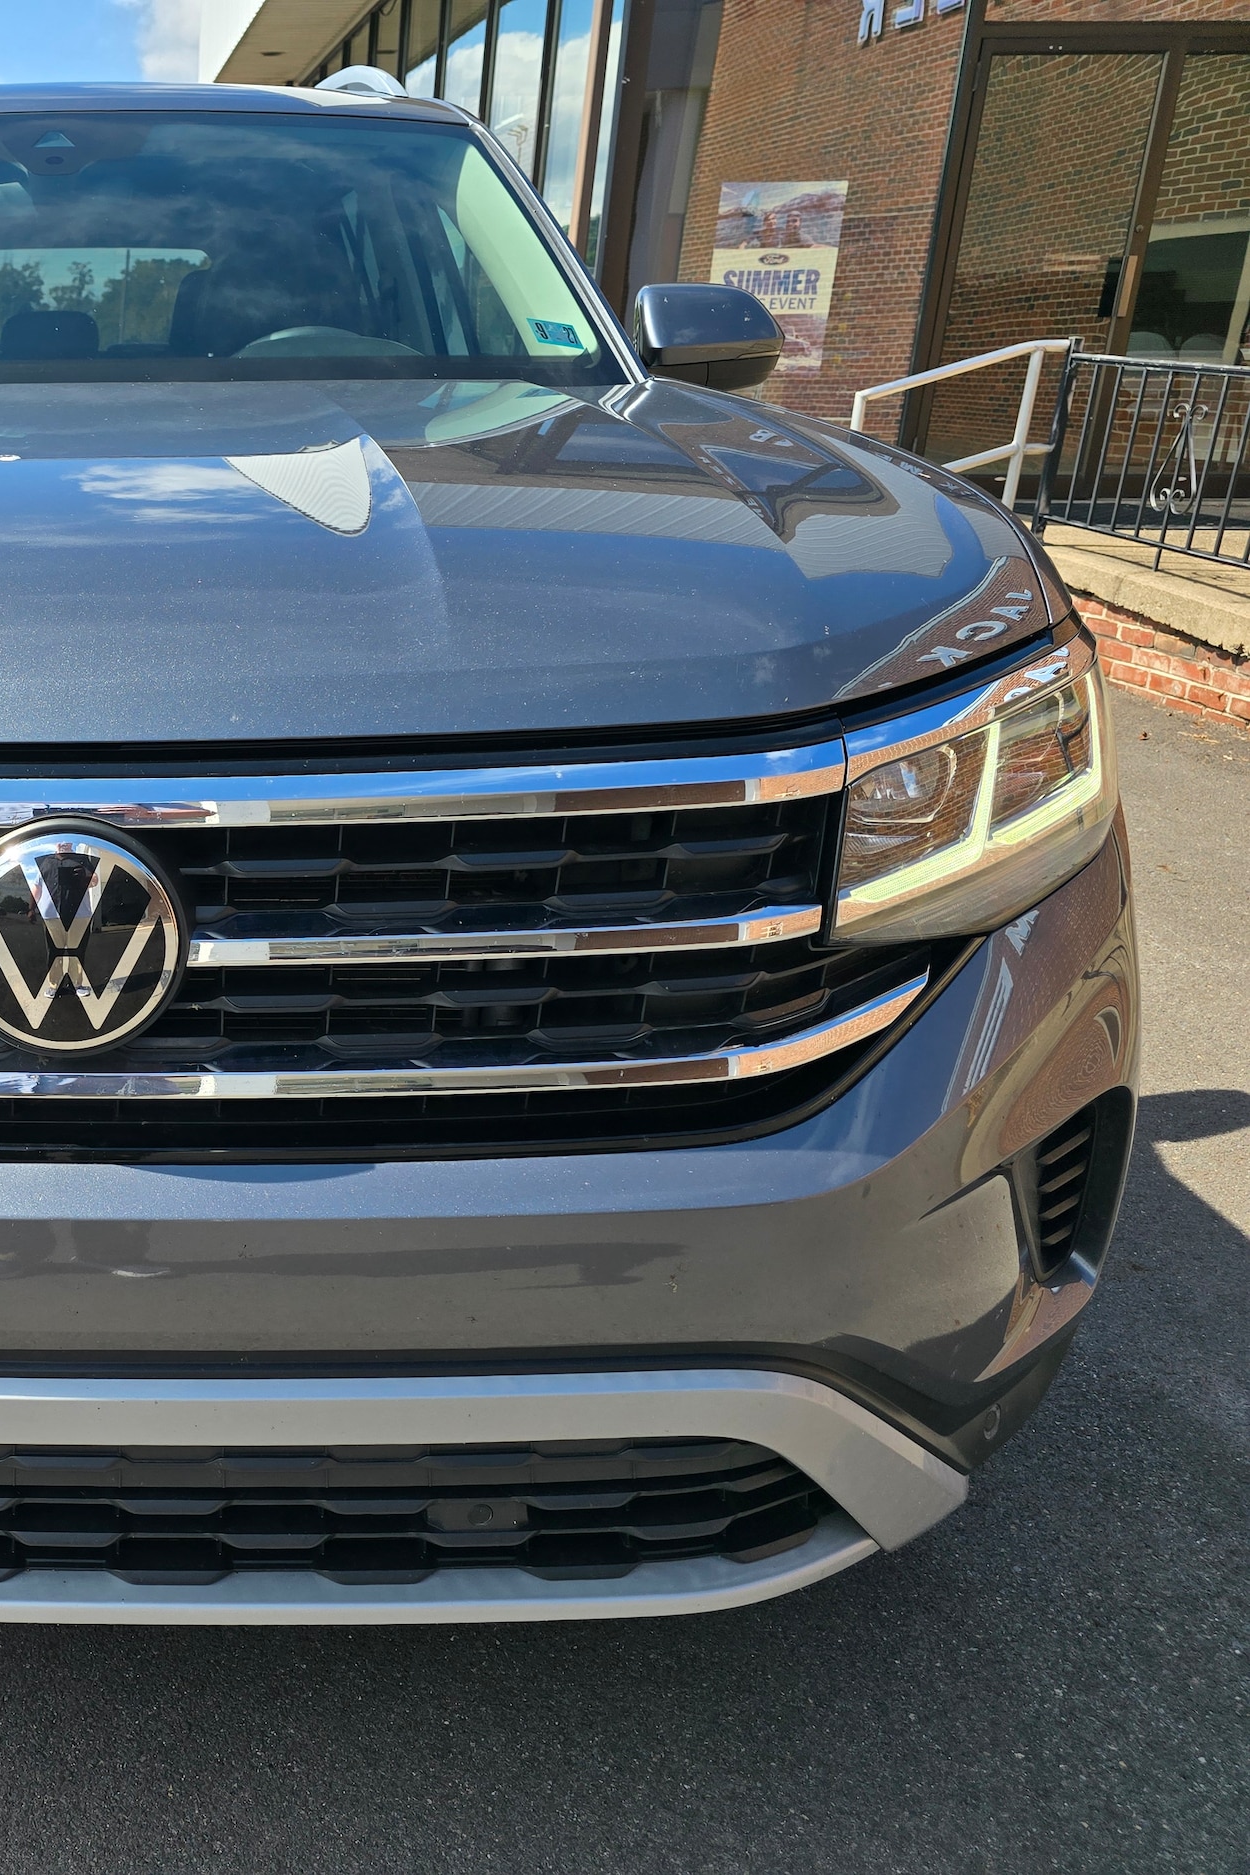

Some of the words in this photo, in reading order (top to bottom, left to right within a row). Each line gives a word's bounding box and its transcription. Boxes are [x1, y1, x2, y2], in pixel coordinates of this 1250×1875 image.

[761, 254, 787, 265] Ford
[723, 269, 820, 295] SUMMER
[769, 298, 817, 310] EVENT
